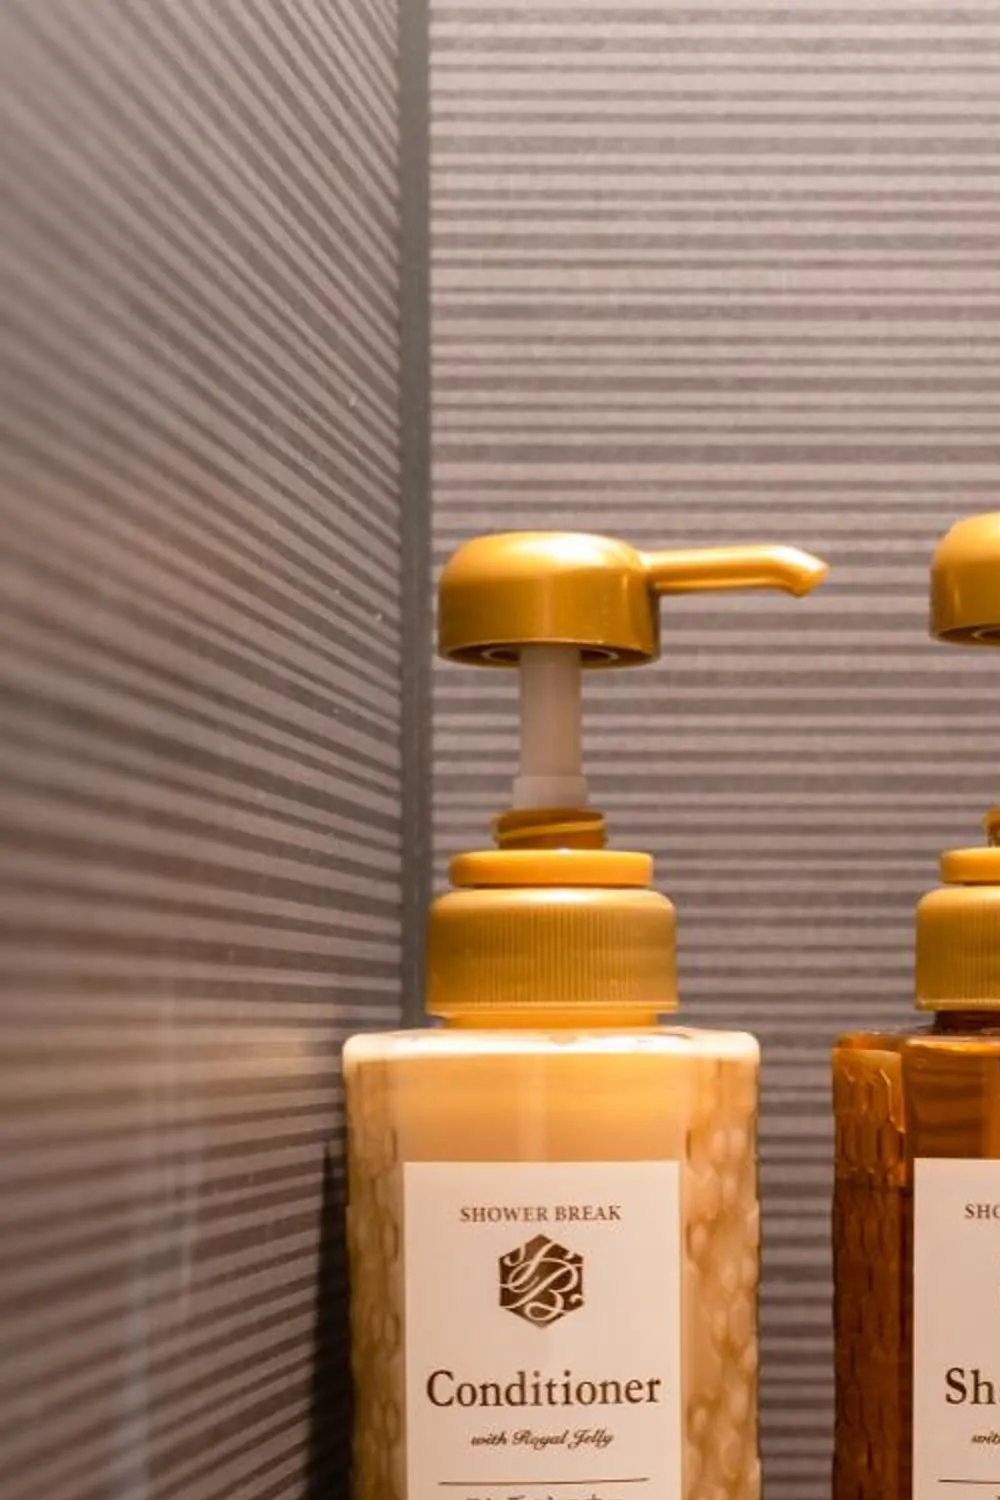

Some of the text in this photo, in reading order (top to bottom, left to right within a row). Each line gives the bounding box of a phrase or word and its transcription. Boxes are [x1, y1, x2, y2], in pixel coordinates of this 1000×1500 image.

[460, 1204, 622, 1223] SHOWER BREAK
[426, 1369, 661, 1407] Conditioner
[470, 1428, 614, 1451] with Royal Jelly
